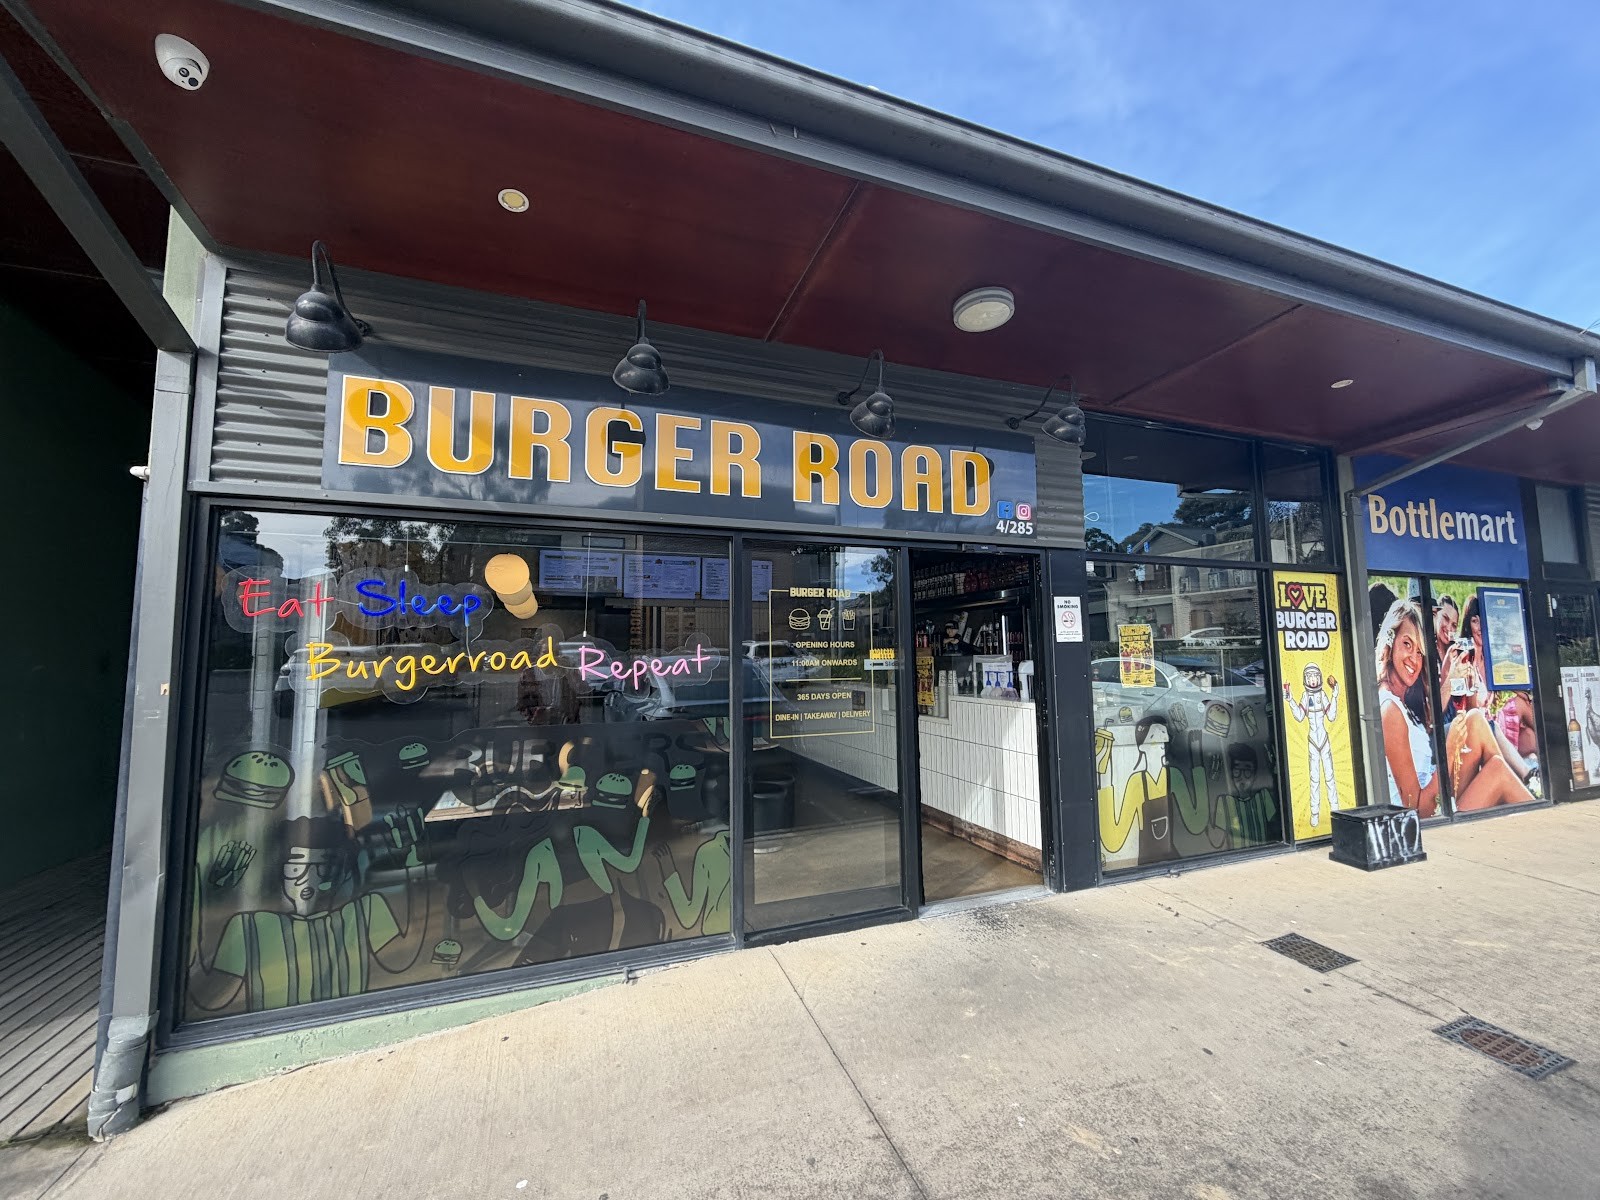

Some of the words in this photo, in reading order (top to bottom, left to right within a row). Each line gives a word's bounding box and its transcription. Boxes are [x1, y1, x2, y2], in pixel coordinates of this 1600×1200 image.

[338, 374, 762, 499] BURGER
[792, 430, 992, 517] ROAD
[996, 520, 1034, 535] 4/285
[1367, 494, 1518, 545] Bottlemart
[789, 587, 825, 598] BURGER
[826, 588, 852, 598] ROAD
[239, 578, 334, 618] Eat
[356, 579, 482, 627] Sleep
[1275, 610, 1336, 630] BURGER
[795, 641, 829, 649] OPENING
[1284, 630, 1329, 649] ROAD
[305, 635, 558, 691] Burgerroad
[578, 643, 711, 691] Repeat
[791, 659, 820, 667] 11:00AM
[821, 658, 858, 667] ONWARDS
[796, 693, 810, 701] 365
[811, 692, 831, 700] DAYS
[831, 691, 852, 699] OPEN
[775, 713, 799, 721] DINE-IN
[803, 711, 838, 720] TAKEAWAY
[841, 709, 871, 718] DELIVERY
